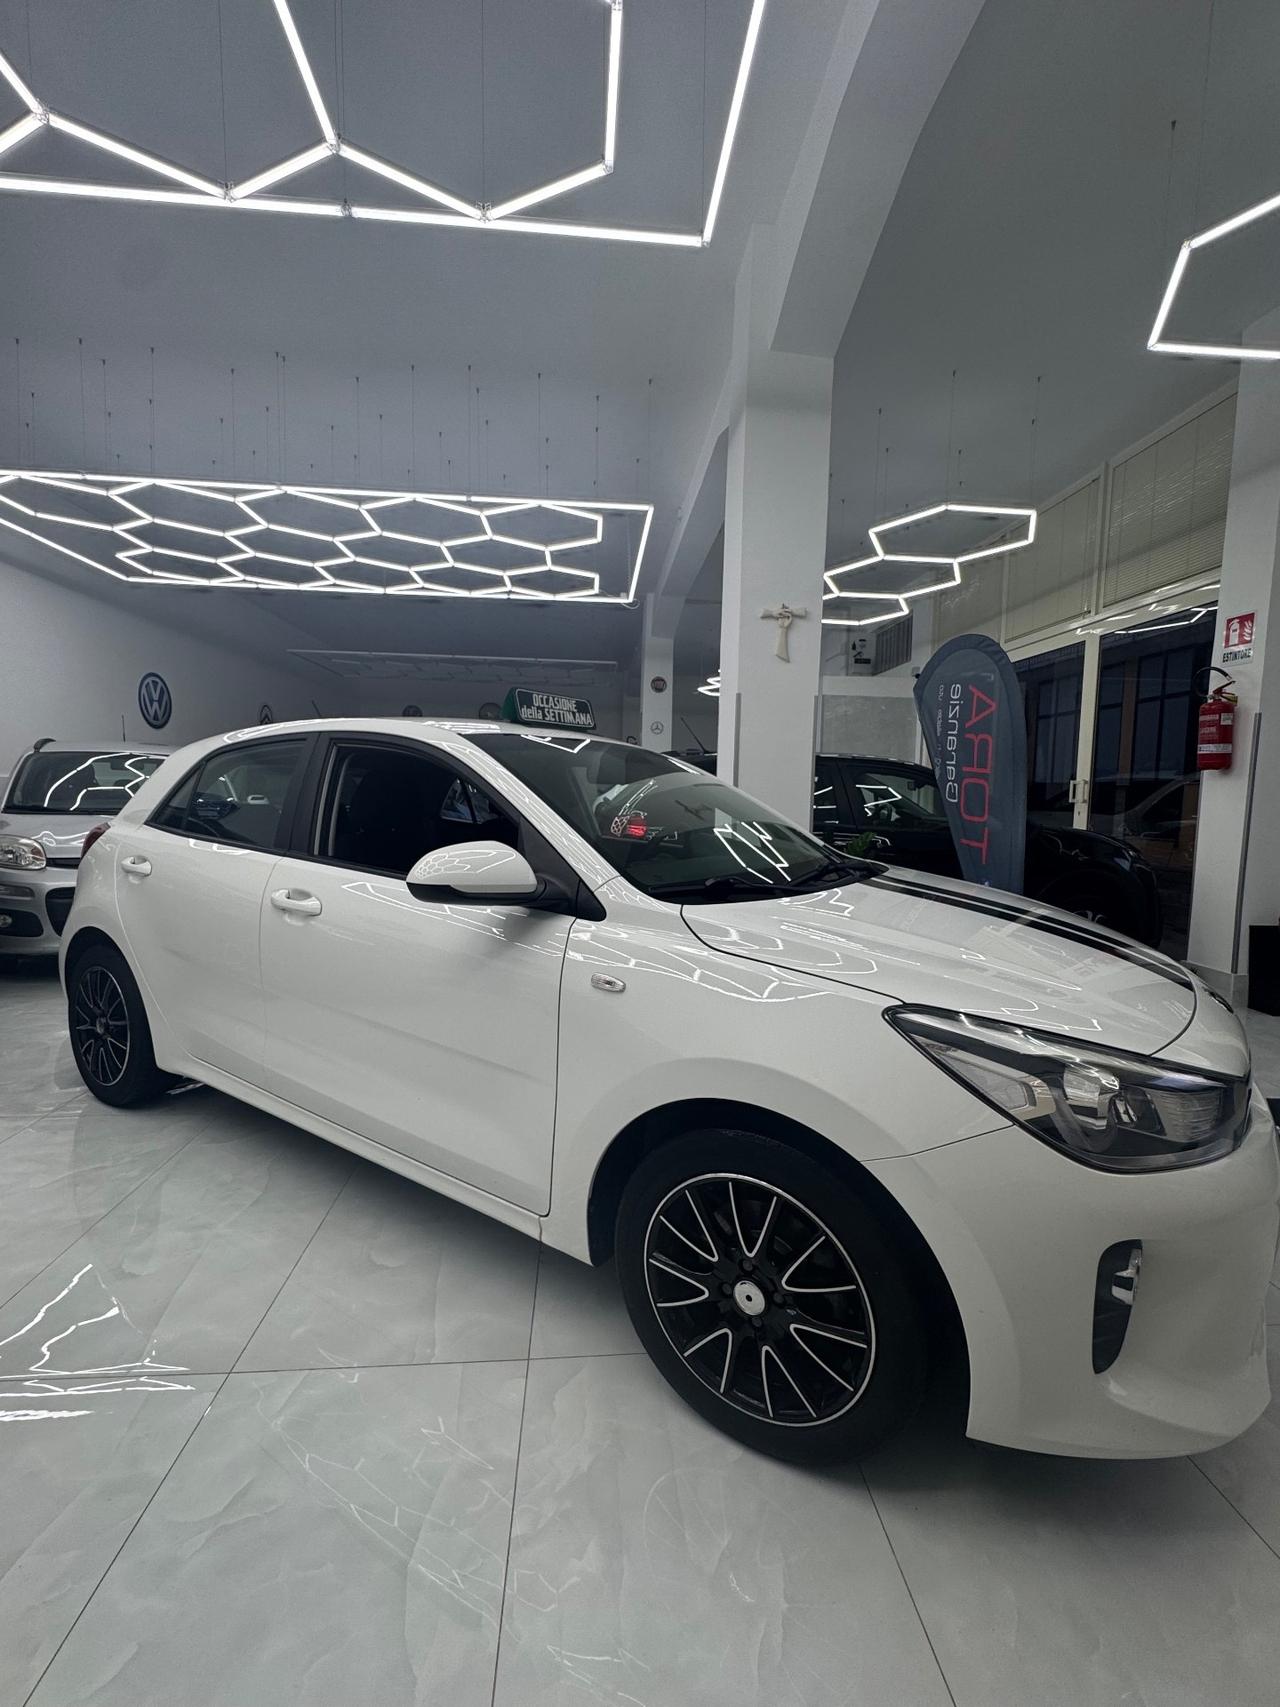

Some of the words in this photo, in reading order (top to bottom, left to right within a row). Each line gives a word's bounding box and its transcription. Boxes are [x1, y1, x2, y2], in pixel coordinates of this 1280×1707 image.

[1222, 647, 1252, 664] ESTINTORE
[532, 693, 578, 712] OCCASIONE
[521, 704, 543, 720] della
[544, 708, 593, 725] SETTIMANA
